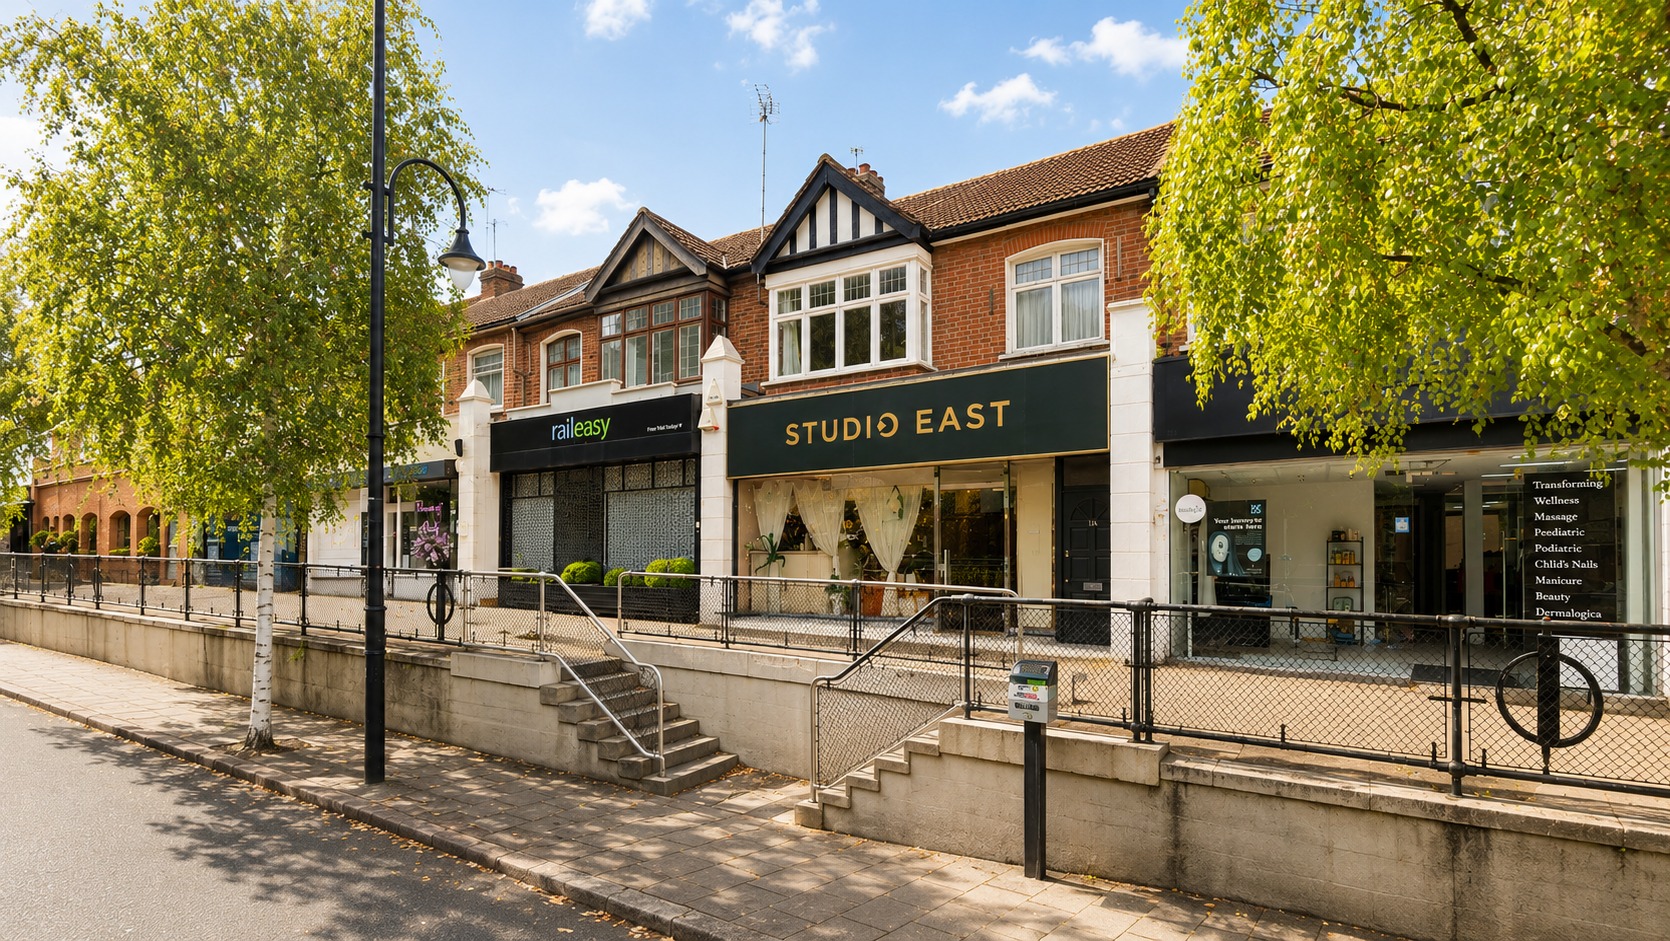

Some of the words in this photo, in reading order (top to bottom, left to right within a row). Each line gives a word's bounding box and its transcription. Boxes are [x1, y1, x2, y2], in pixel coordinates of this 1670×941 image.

[551, 416, 611, 441] raileasy
[785, 412, 899, 446] STUDIO
[916, 400, 1011, 434] EAST
[1532, 479, 1604, 490] Transforming
[1533, 495, 1580, 505] Wellness
[1534, 512, 1578, 523] Massage
[1534, 543, 1582, 553] Podiatric
[1535, 575, 1583, 585] Manicure
[1535, 591, 1571, 603] Beauty
[1535, 607, 1602, 621] Dermalogica
